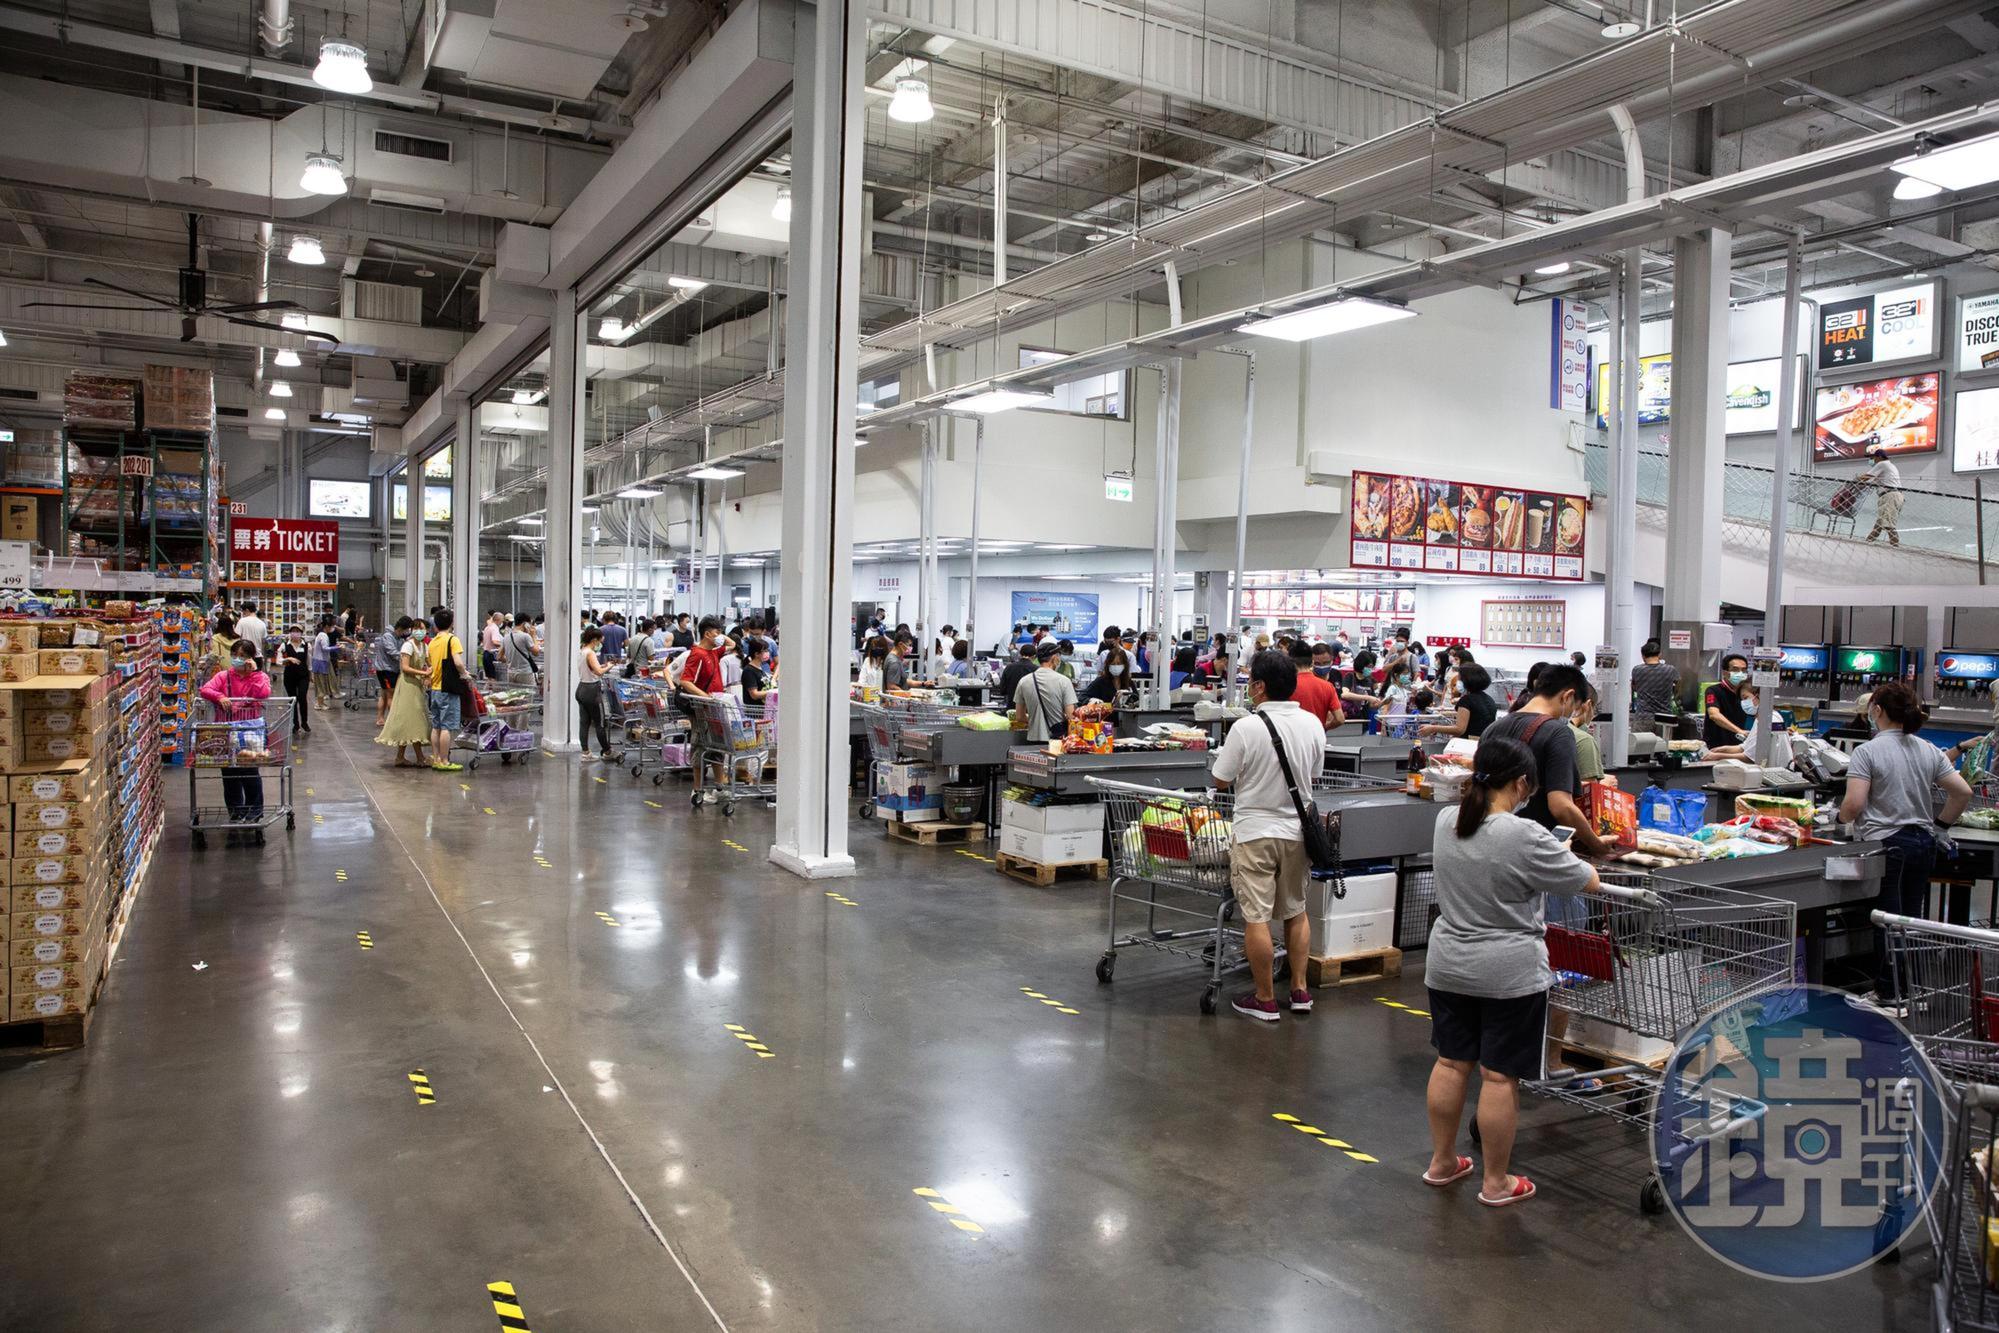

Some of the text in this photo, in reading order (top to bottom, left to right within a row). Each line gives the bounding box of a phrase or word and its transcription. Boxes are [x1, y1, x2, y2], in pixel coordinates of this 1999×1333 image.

[1974, 299, 1999, 308] YAMAHA
[1825, 325, 1866, 345] HEAT
[1966, 330, 1998, 345] TRUE
[123, 456, 150, 474] 202 201
[231, 503, 246, 513] 231
[234, 529, 336, 552] 票券 TICKET
[2, 576, 21, 585] 499
[1788, 654, 1819, 665] pepsi
[1959, 658, 1997, 674] pepsi
